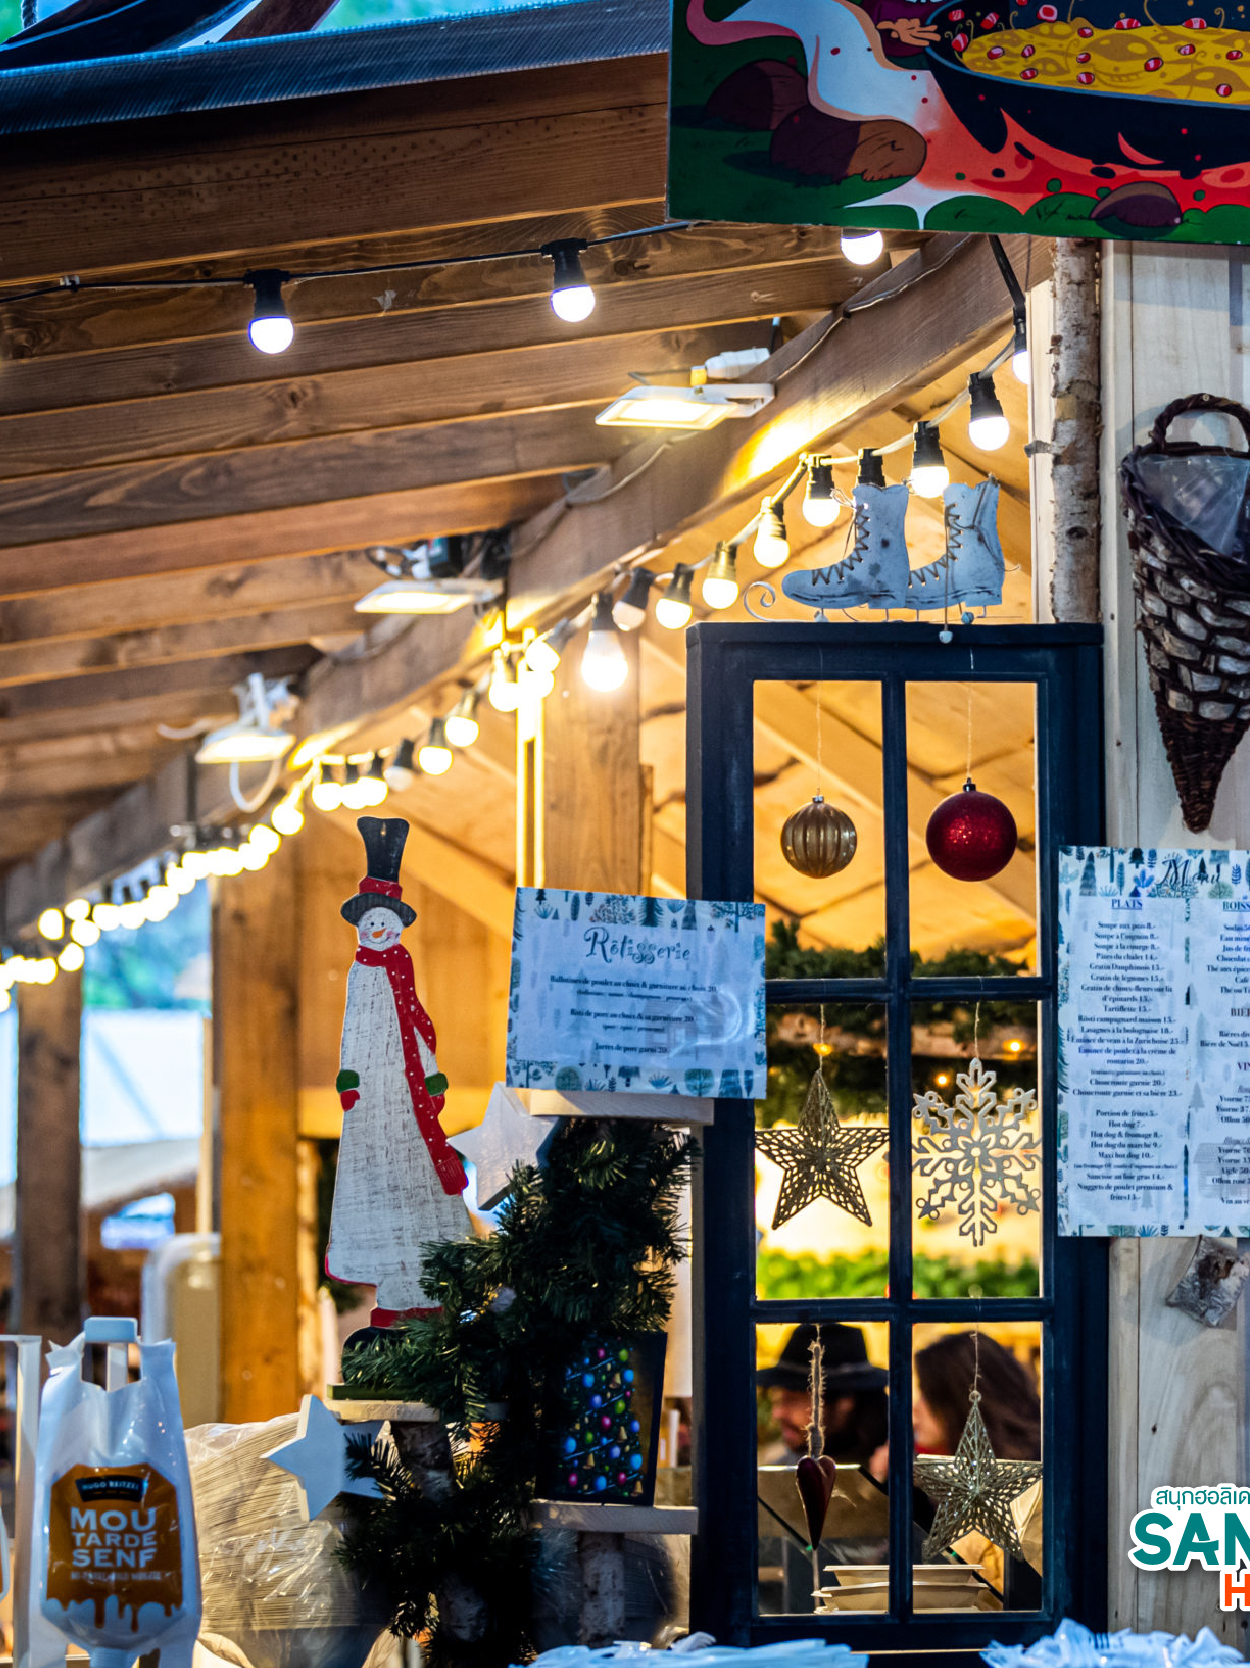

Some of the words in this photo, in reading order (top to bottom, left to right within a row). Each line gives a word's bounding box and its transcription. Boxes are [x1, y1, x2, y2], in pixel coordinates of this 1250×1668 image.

[1155, 859, 1220, 886] Menu
[1112, 899, 1142, 910] PLATS
[584, 926, 690, 964] Rôtisserie
[1122, 1121, 1135, 1129] dog
[1104, 1131, 1117, 1139] dog
[1104, 1141, 1117, 1149] dog
[71, 1507, 157, 1532] MOU
[72, 1531, 157, 1548] TARDE
[72, 1548, 157, 1568] SENF
